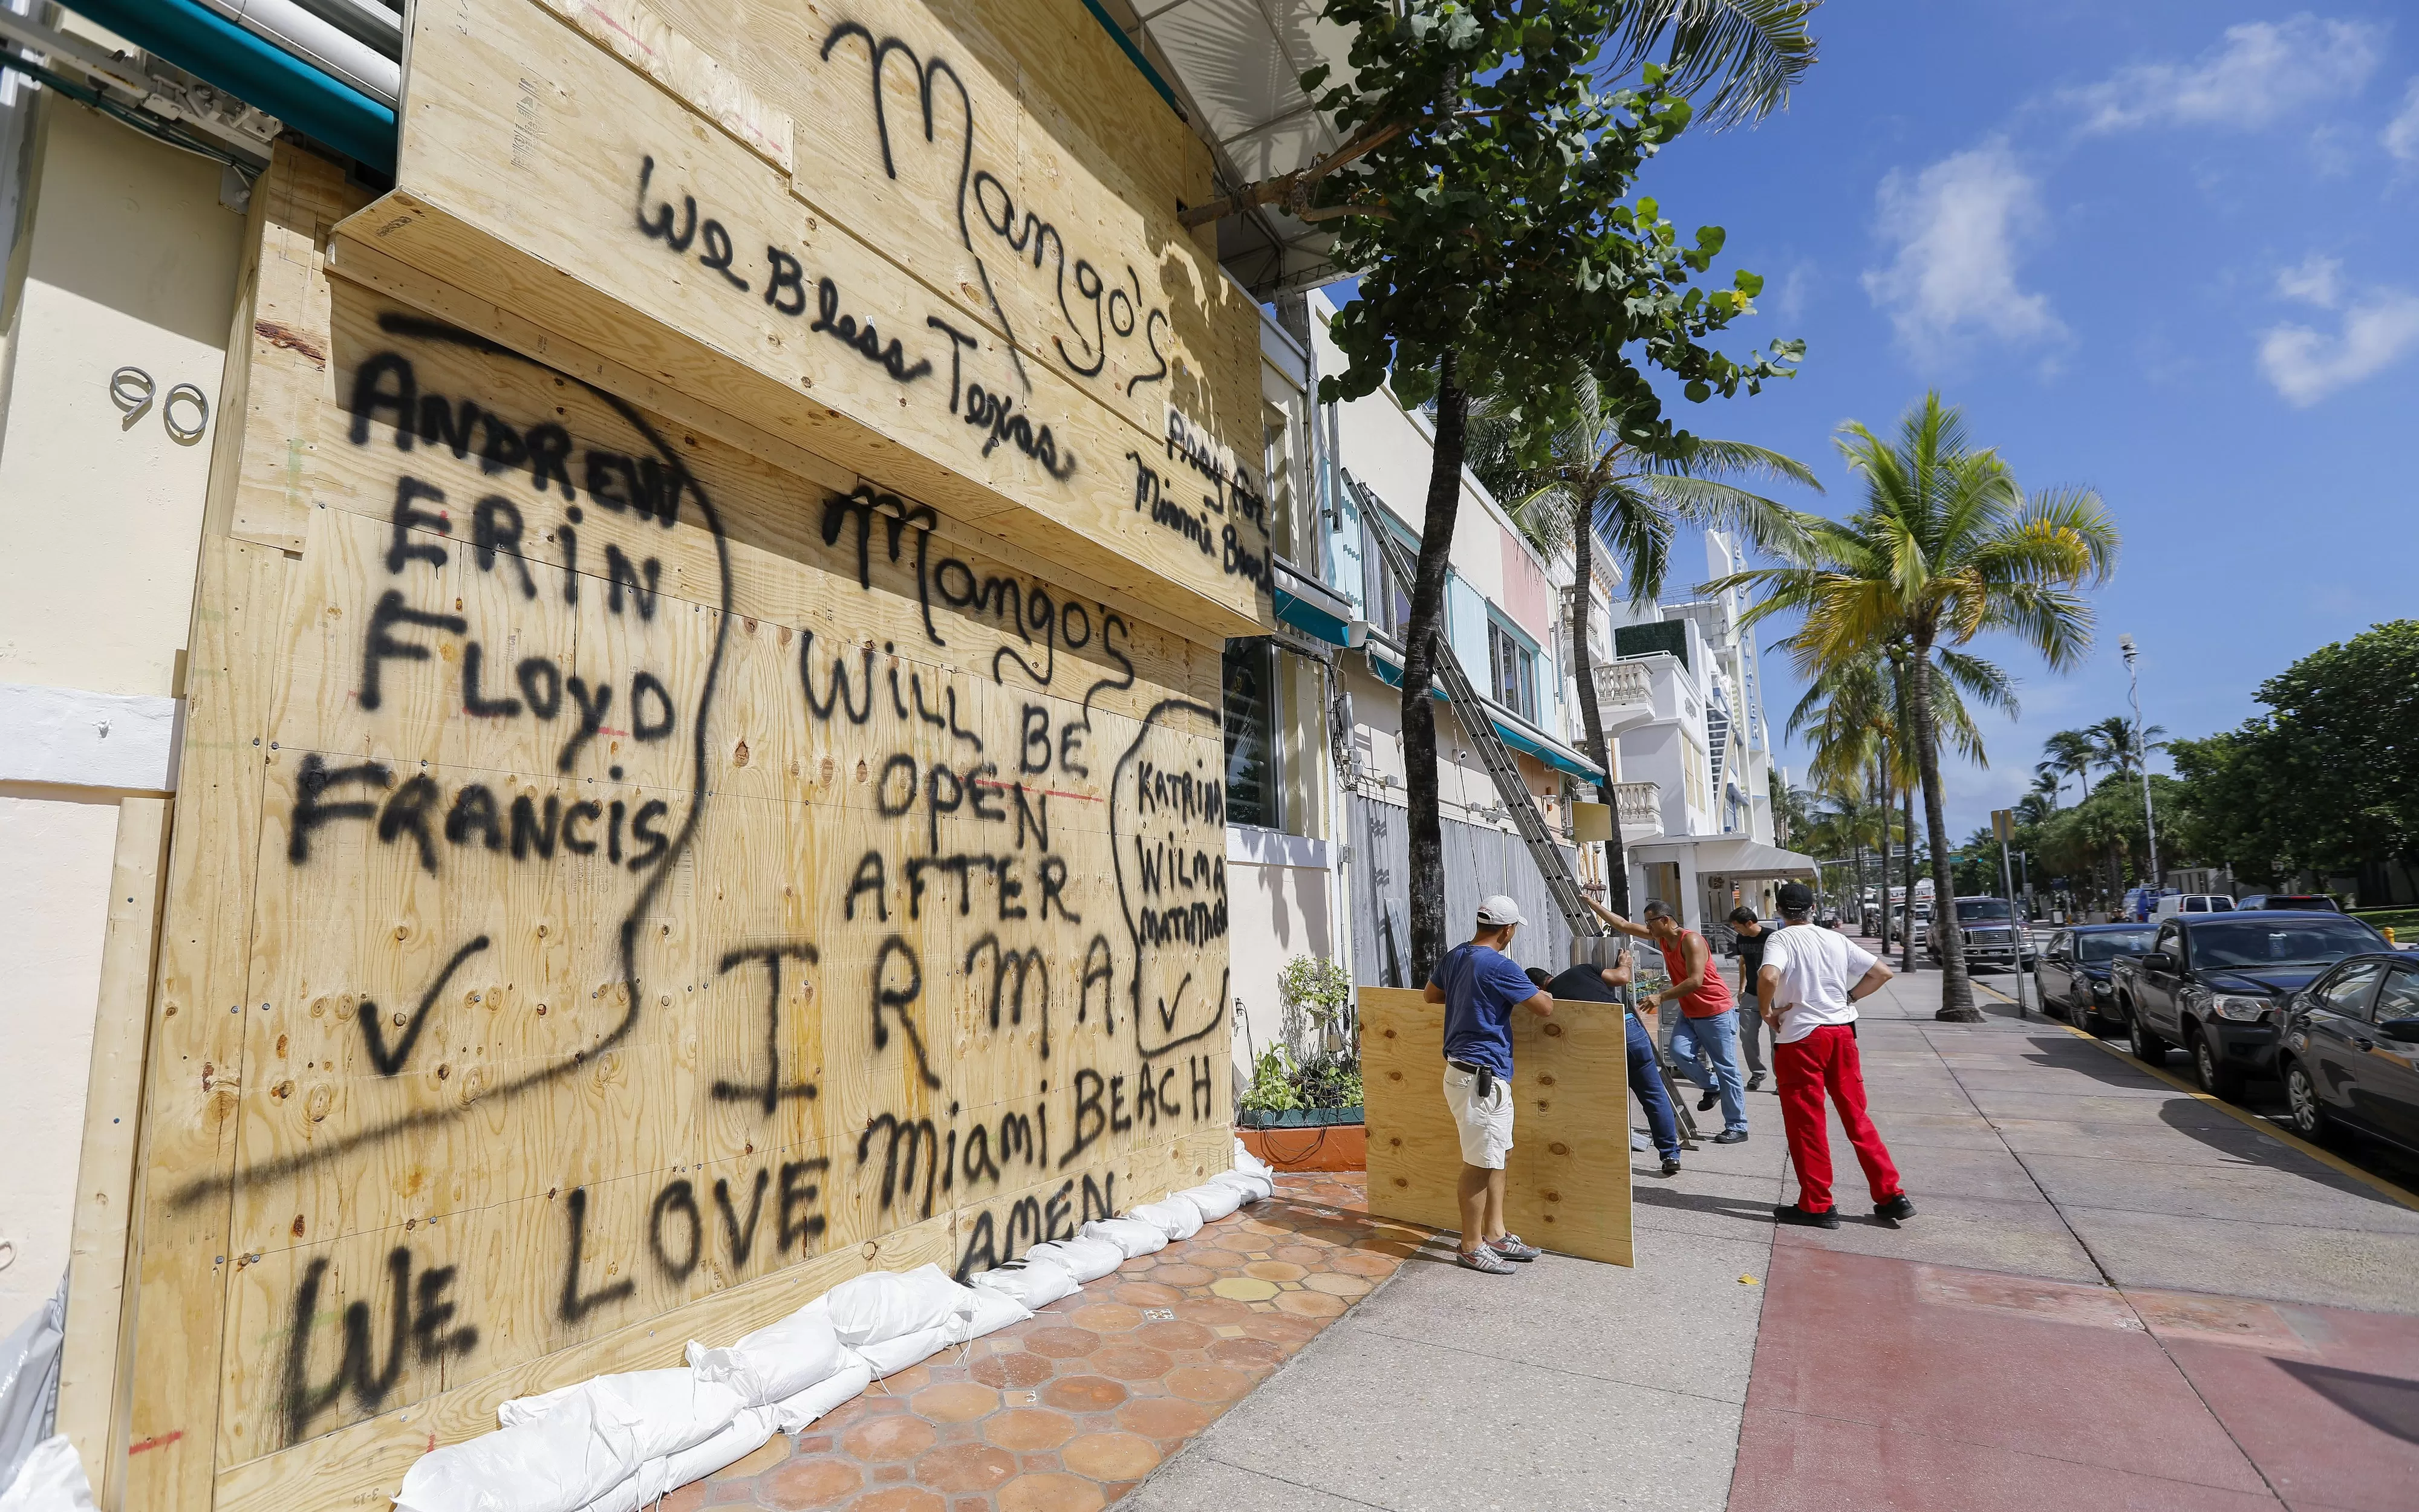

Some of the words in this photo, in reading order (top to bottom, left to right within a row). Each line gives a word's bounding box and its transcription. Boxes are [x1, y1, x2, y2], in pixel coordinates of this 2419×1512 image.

[635, 154, 750, 293] We
[819, 20, 1169, 400] Mango's
[111, 365, 209, 436] 90
[348, 351, 683, 529] ANDREW
[357, 588, 676, 774] FLOYD
[1020, 701, 1092, 779] BE
[876, 750, 1050, 855] OPEN
[844, 848, 1083, 925] AFTER
[710, 931, 1116, 1116] IRMA
[1058, 1053, 1212, 1169] BEACH
[954, 1170, 1115, 1283] AMEN
[279, 1245, 480, 1445] WE
[553, 1155, 830, 1325] LOVE
